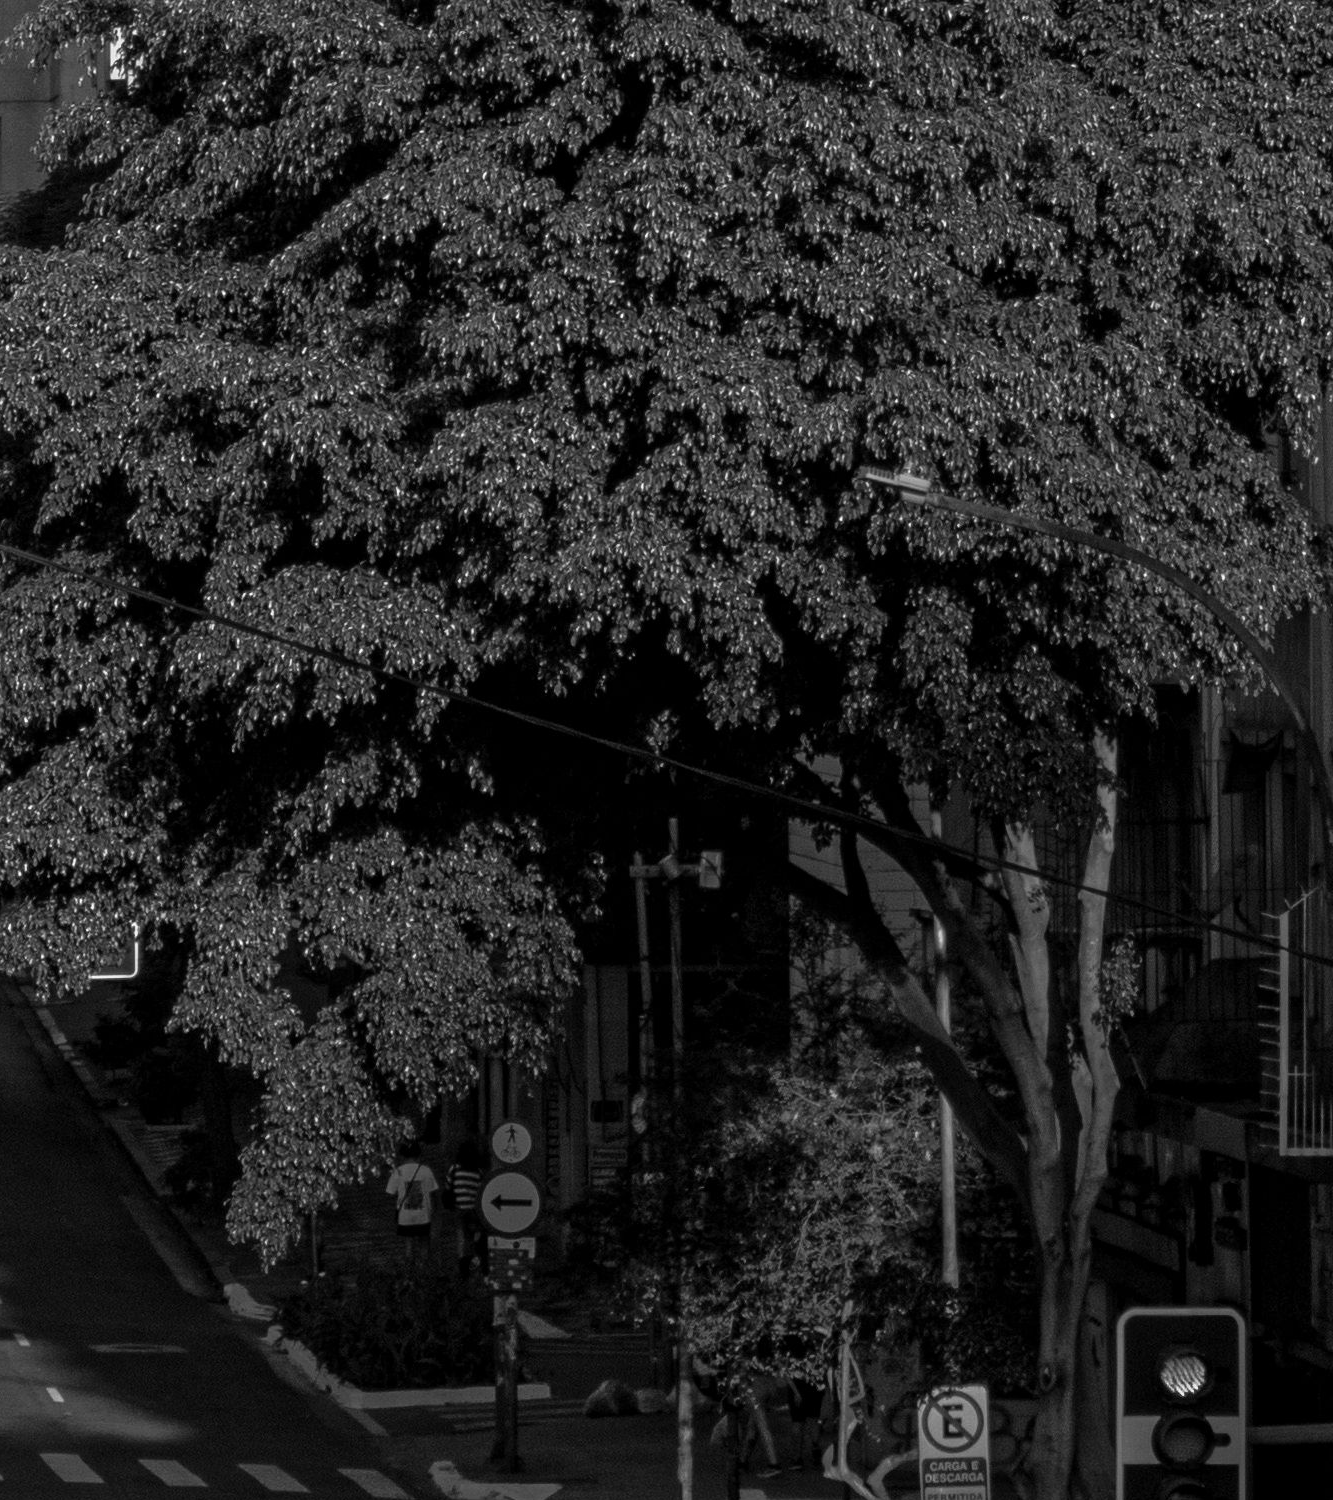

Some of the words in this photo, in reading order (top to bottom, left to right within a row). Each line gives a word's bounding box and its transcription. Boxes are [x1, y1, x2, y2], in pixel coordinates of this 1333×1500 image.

[929, 1461, 968, 1472] CARGA
[971, 1460, 980, 1471] E
[924, 1472, 985, 1484] DESCARGA
